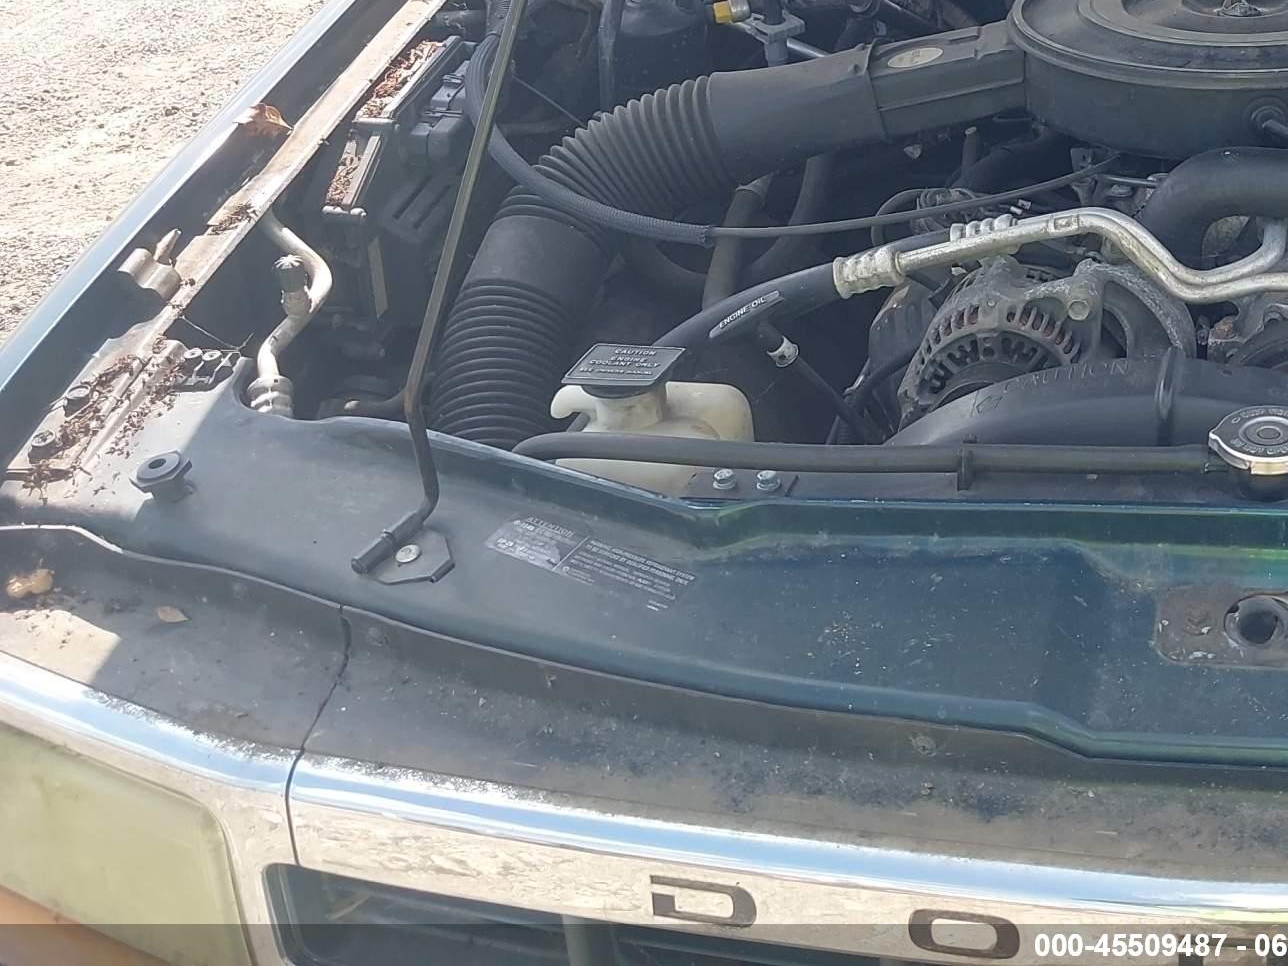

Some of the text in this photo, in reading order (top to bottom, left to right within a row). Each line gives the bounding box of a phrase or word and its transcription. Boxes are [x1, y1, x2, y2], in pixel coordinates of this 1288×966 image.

[719, 297, 768, 328] ENGINE OIL
[589, 359, 632, 367] COOLANT
